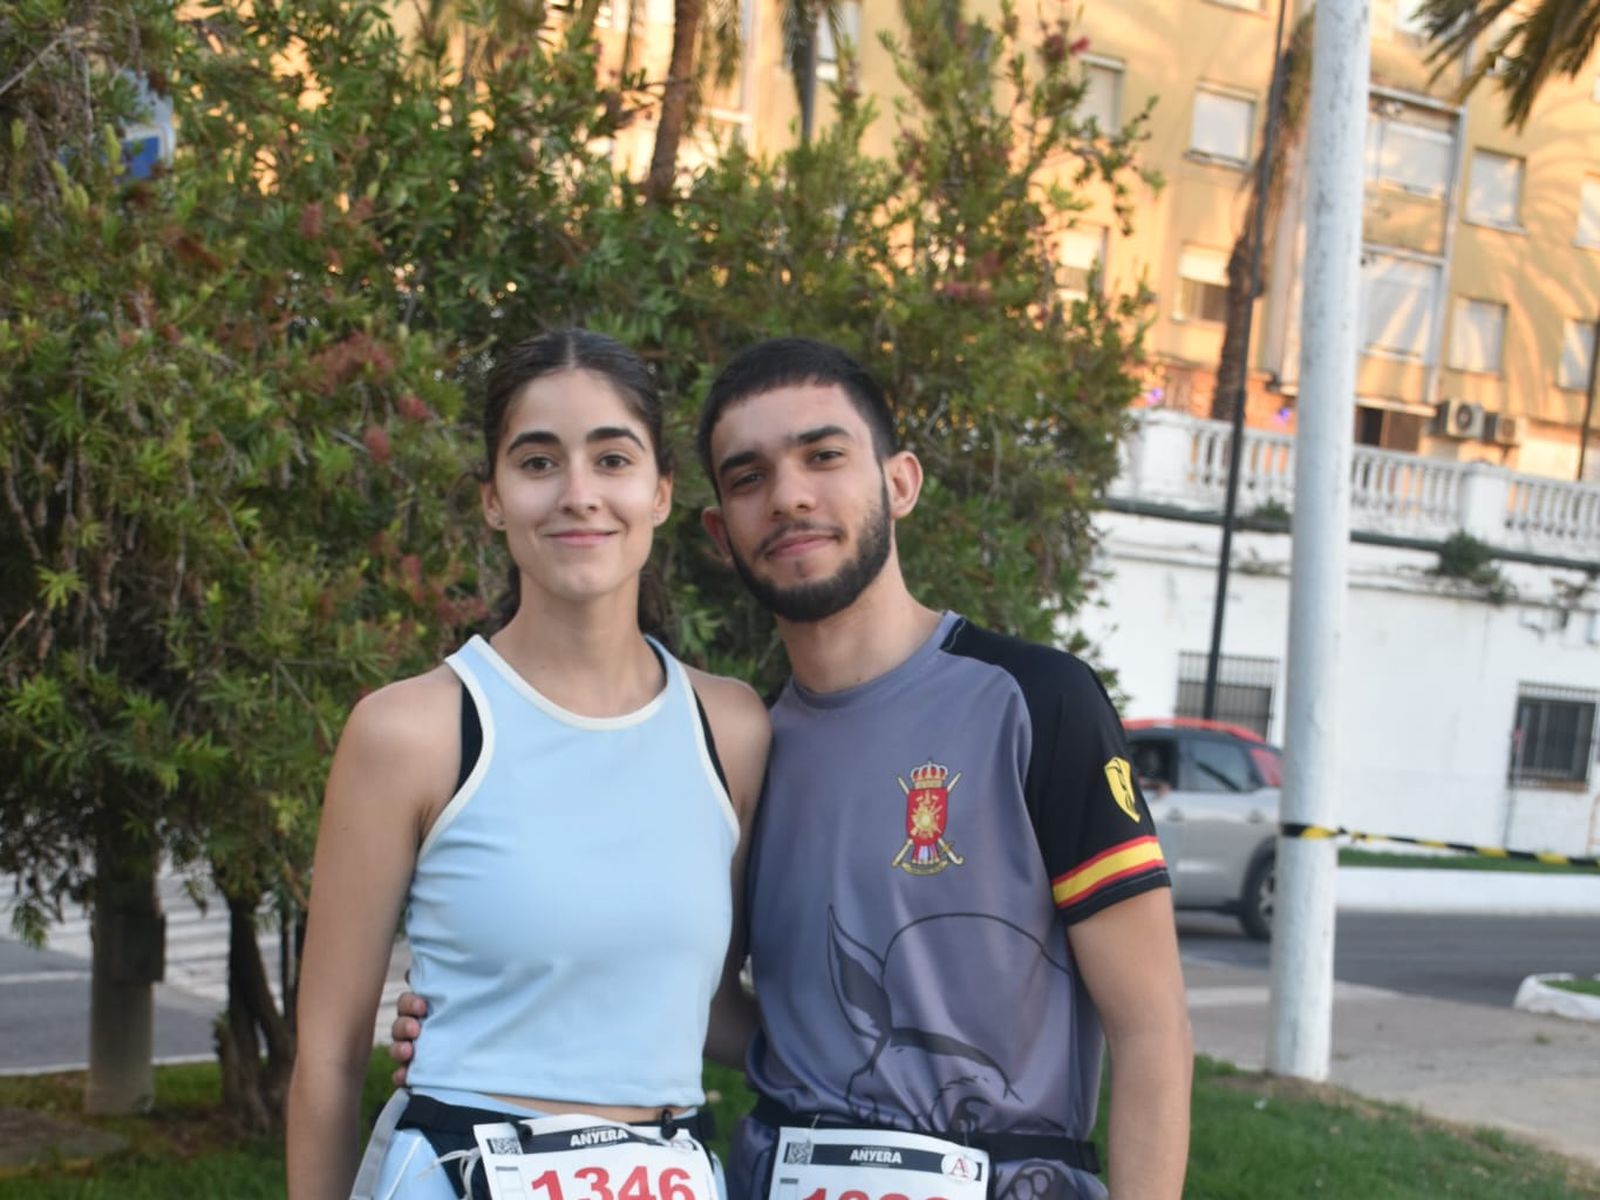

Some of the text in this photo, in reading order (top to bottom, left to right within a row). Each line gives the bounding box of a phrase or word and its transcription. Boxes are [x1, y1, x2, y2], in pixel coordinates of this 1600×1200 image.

[569, 1128, 629, 1147] ANYERA
[850, 1149, 903, 1164] ANYERA
[950, 1157, 969, 1178] A
